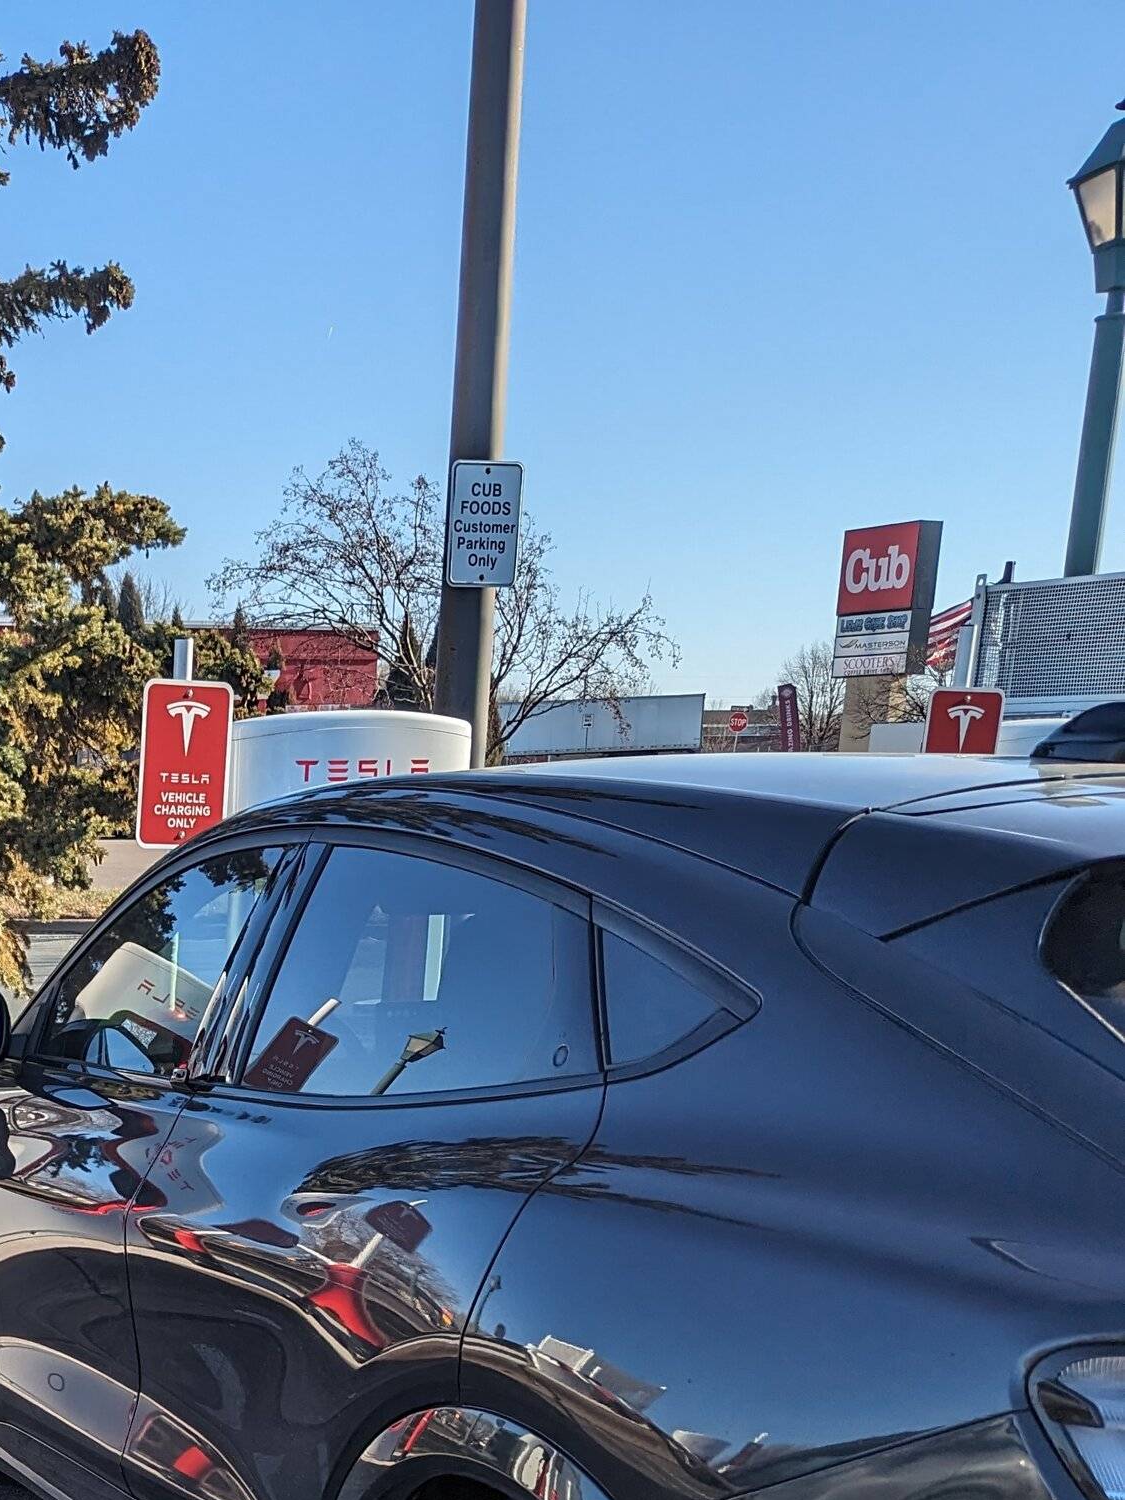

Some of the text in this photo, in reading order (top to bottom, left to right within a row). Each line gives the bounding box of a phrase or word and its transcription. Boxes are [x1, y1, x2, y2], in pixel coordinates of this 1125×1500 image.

[471, 482, 502, 497] CUB
[460, 501, 511, 516] FOODS
[454, 519, 516, 534] Customer
[457, 536, 506, 554] Parking
[468, 553, 497, 570] Only
[845, 544, 910, 594] Cub
[854, 639, 906, 649] MASTERSON
[730, 718, 747, 727] STOP
[159, 772, 210, 785] TESLA
[160, 791, 207, 804] VEHICLE
[153, 804, 212, 816] CHARGING
[167, 817, 196, 829] ONLY
